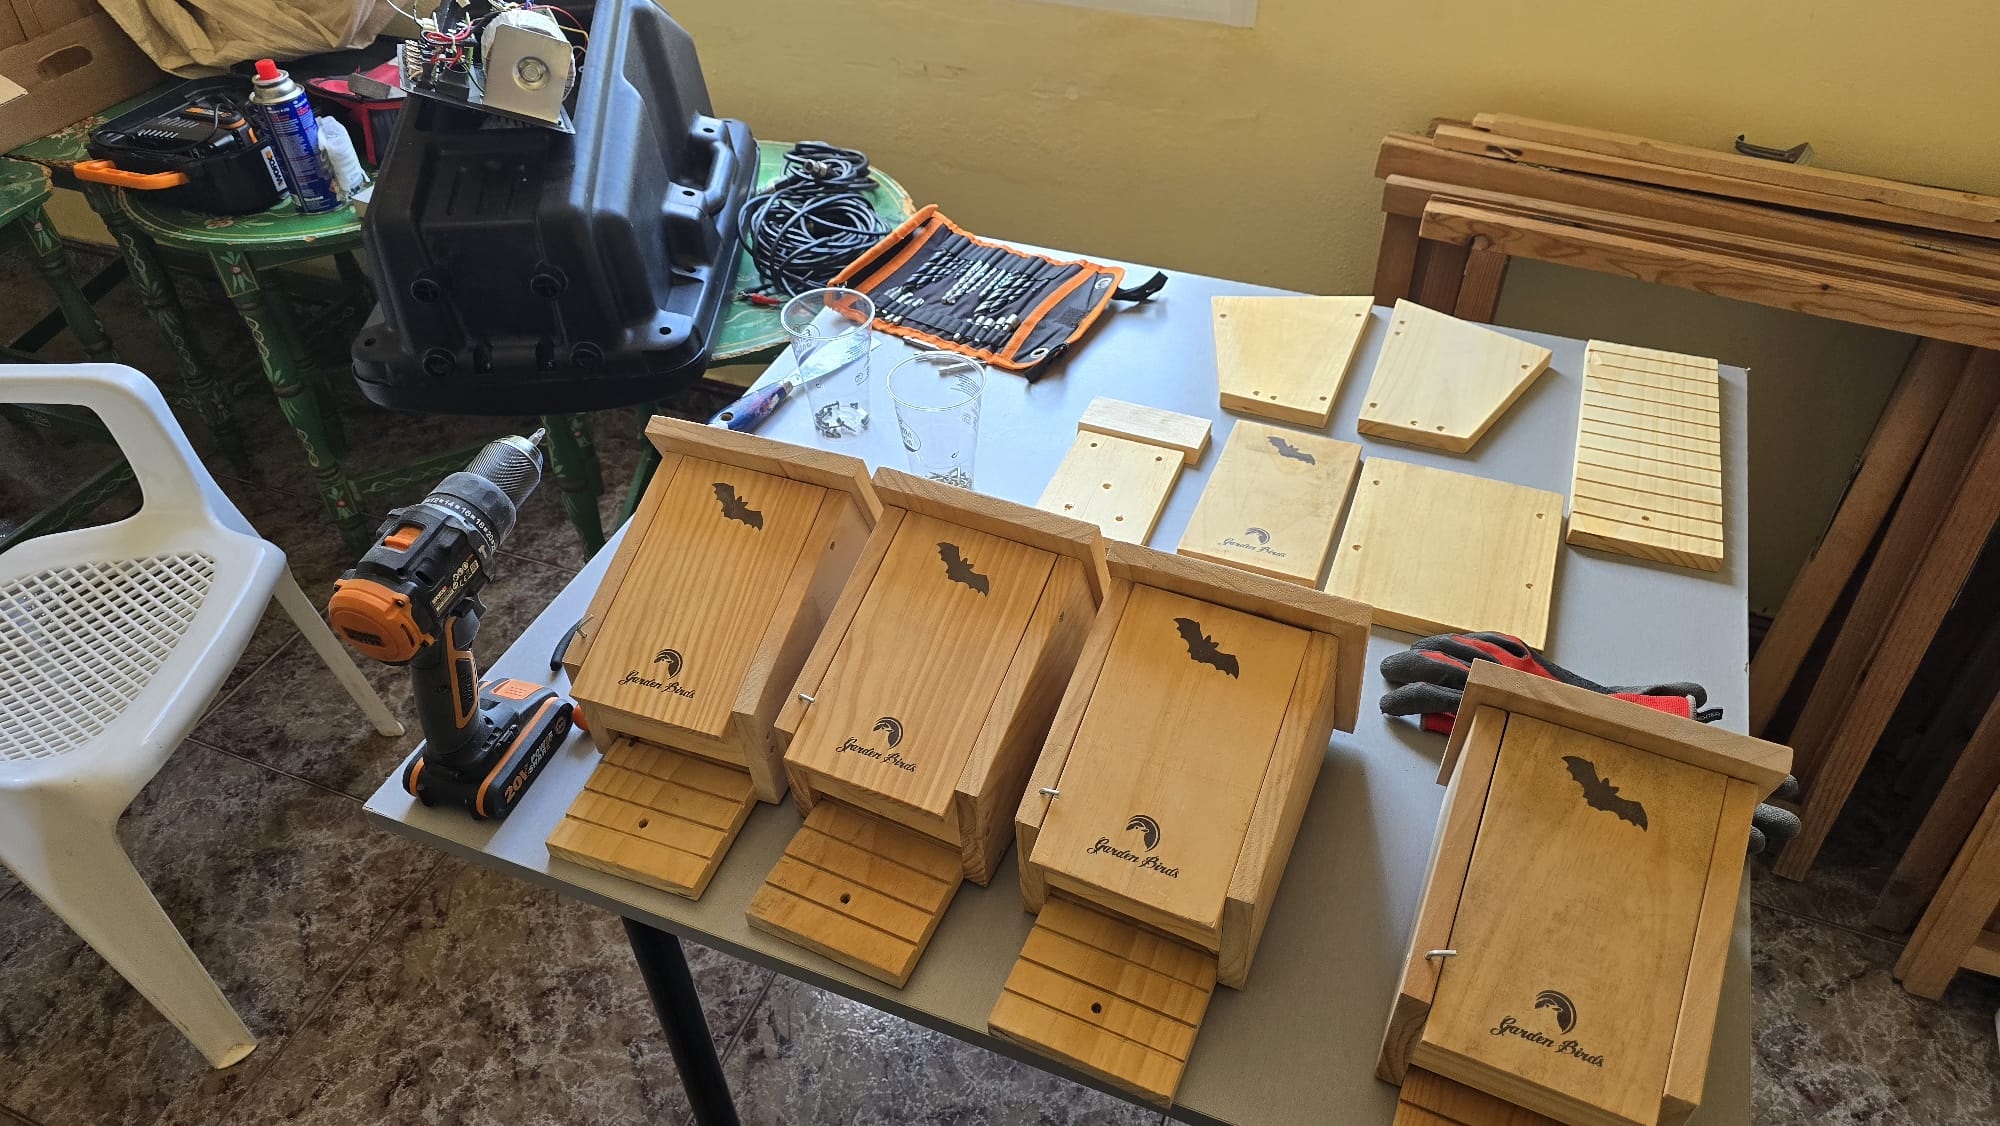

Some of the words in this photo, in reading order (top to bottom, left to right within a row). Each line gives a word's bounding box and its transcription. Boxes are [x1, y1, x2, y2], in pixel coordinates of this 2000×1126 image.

[618, 669, 662, 690] Garden
[661, 681, 696, 699] Birds
[836, 737, 882, 760] Garden
[880, 752, 917, 773] Birds
[1086, 836, 1140, 863] Garden
[1138, 855, 1180, 879] Birds
[1490, 1015, 1556, 1048] Garden
[1554, 1040, 1605, 1068] Birds
